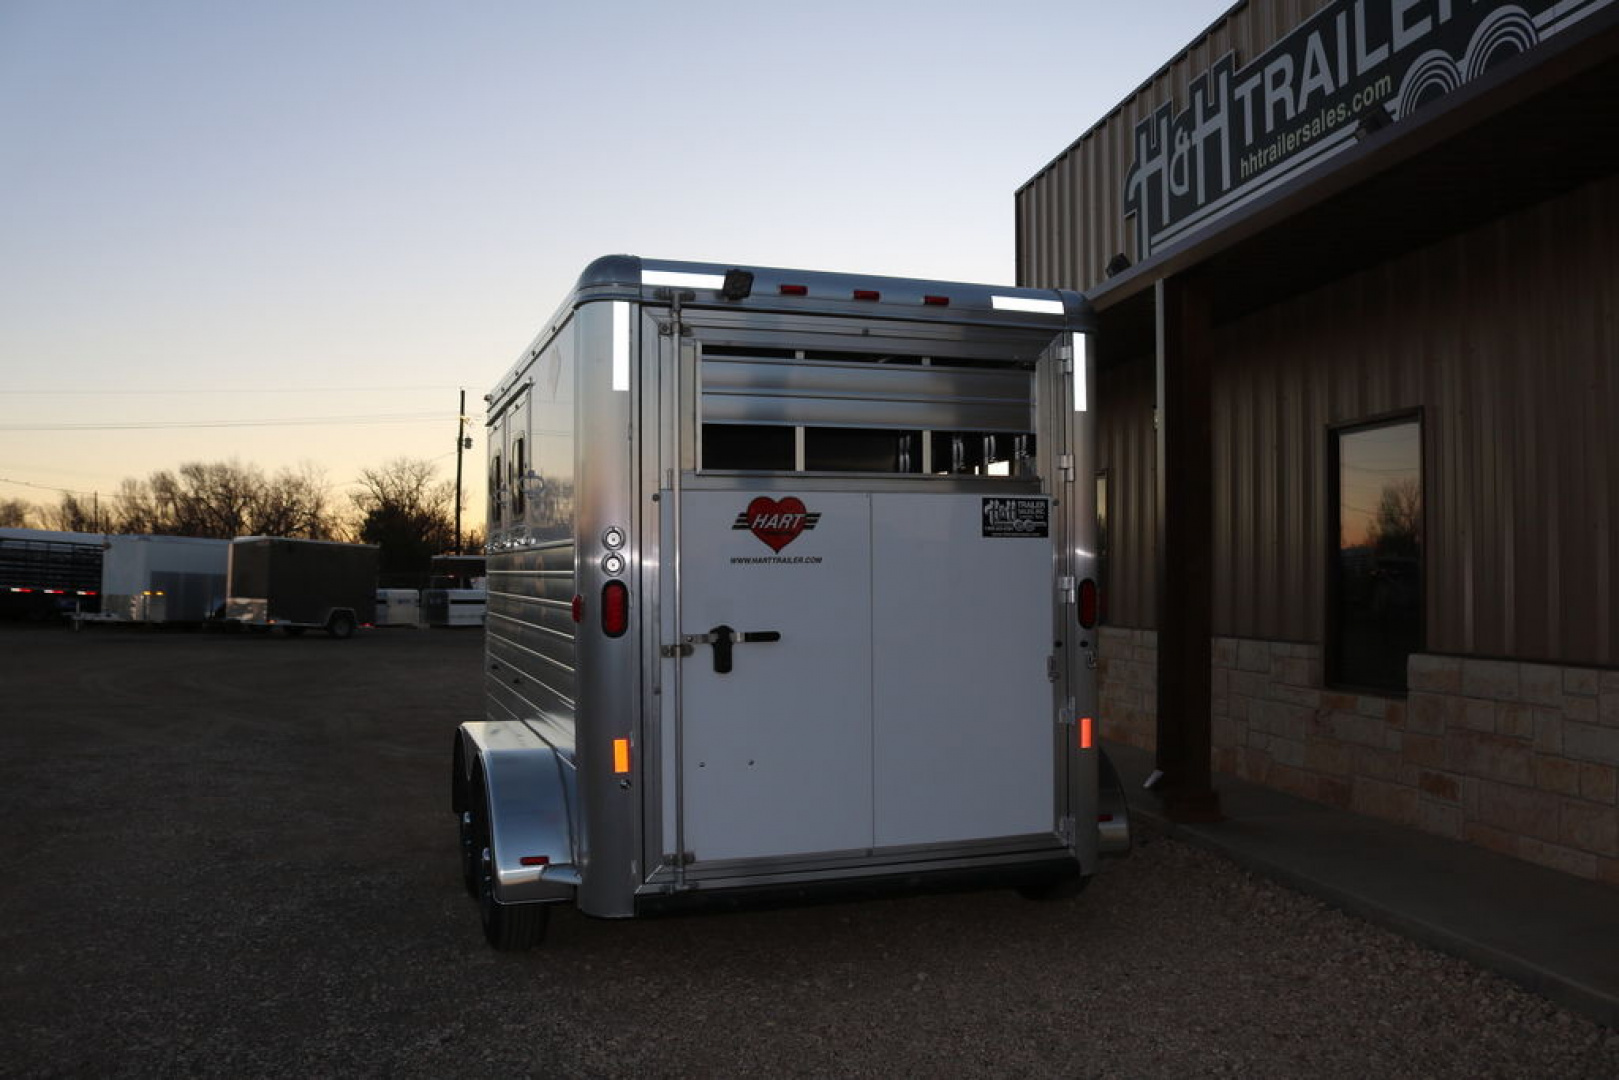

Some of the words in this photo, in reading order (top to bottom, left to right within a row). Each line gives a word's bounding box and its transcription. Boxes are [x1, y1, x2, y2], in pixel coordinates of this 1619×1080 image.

[1240, 73, 1393, 179] hhtrailersales.com
[1128, 70, 1231, 261] H&H
[751, 513, 806, 529] HART
[730, 556, 823, 564] WWW.HARTTRAILER.COM
